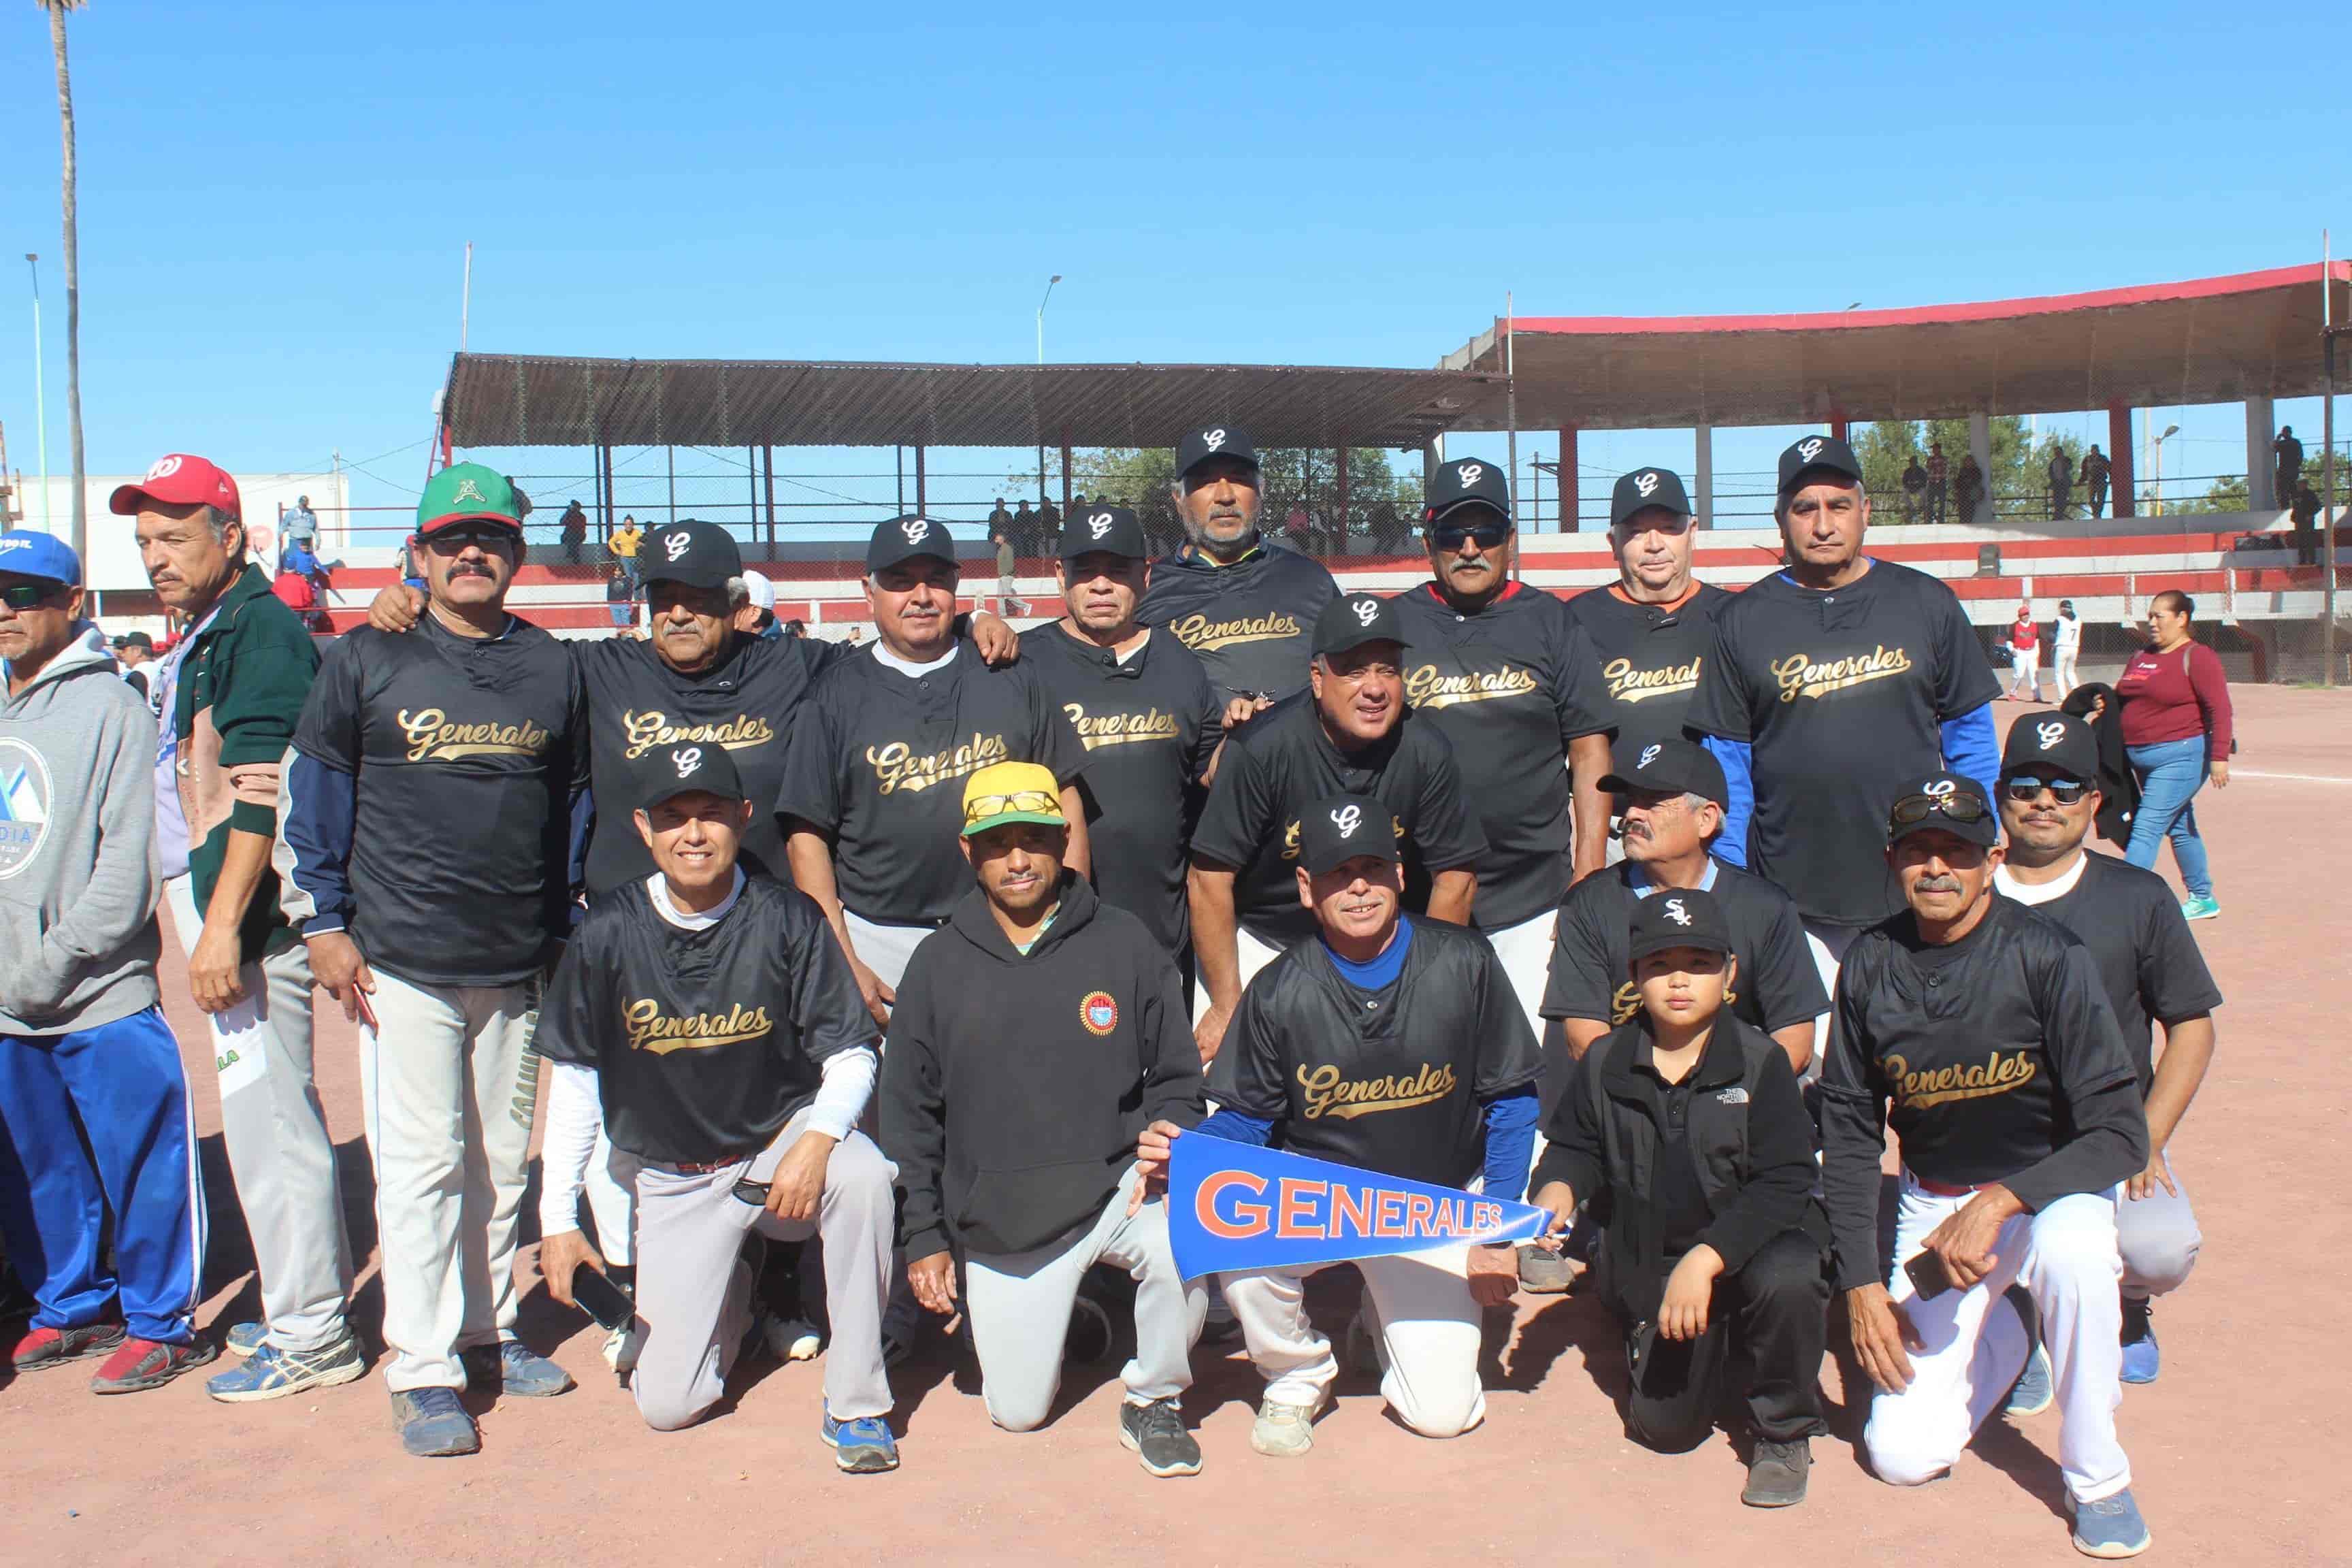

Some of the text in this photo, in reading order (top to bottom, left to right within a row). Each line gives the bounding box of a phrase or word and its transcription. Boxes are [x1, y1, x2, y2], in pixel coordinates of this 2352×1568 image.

[1203, 429, 1226, 453] G
[1798, 438, 1824, 463] G
[1458, 465, 1483, 489] G
[1635, 473, 1659, 498] G
[452, 479, 487, 506] A
[902, 519, 929, 546] G
[1089, 512, 1114, 540] G
[664, 532, 691, 562] G
[1352, 600, 1379, 627] G
[1170, 611, 1301, 651] Generales
[1401, 664, 1537, 710] Generales
[1771, 644, 1912, 702] Generales
[622, 708, 774, 760] Generales
[2036, 721, 2066, 751] G
[672, 747, 702, 779] G
[866, 732, 1008, 796] Generales
[1637, 742, 1662, 770] G
[1330, 805, 1362, 839] G
[621, 997, 774, 1051] Generales
[1296, 1062, 1456, 1120] Generales
[1194, 1169, 1502, 1240] GENERALES
